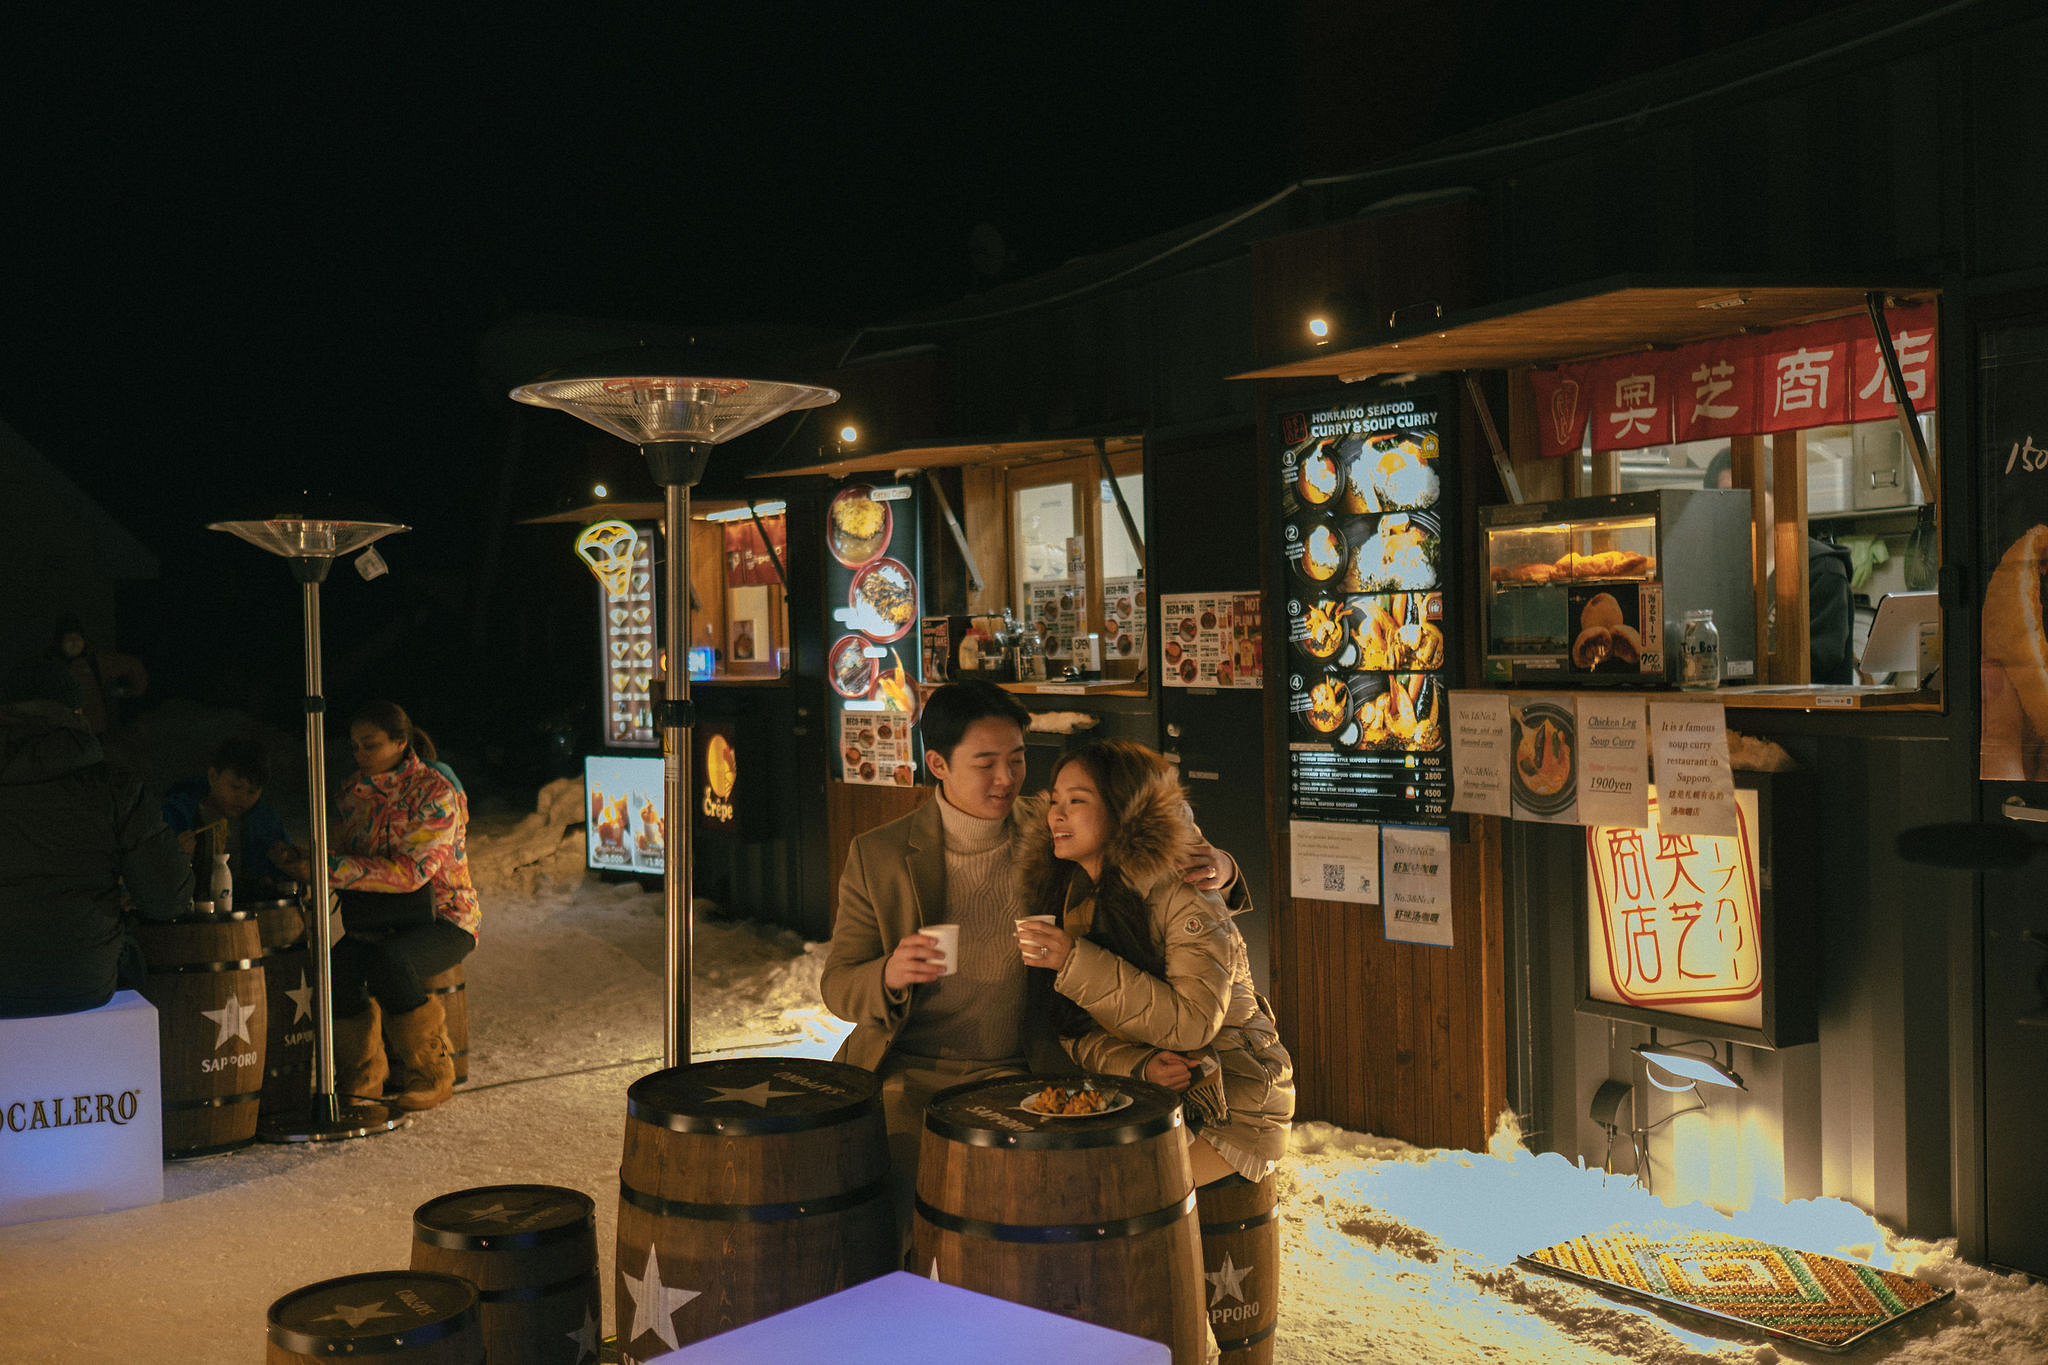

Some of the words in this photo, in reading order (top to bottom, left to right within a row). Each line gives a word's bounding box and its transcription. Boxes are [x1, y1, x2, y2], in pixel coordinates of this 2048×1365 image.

[1312, 407, 1364, 423] HOKKAIDO
[1367, 401, 1415, 417] SEAFOOD
[1311, 422, 1351, 438] CURRY
[1363, 416, 1395, 432] SOUP
[1396, 412, 1438, 428] CURRY
[1074, 639, 1090, 650] OPEN
[1681, 642, 1695, 656] Tip
[1699, 641, 1717, 653] Box
[1641, 653, 1659, 664] 700
[1588, 716, 1619, 727] Chicken
[1622, 717, 1637, 729] Leg
[1662, 722, 1669, 732] It
[1670, 721, 1677, 732] is
[1685, 722, 1715, 733] famous
[1591, 736, 1610, 748] Soup
[1612, 736, 1636, 749] Curry
[1669, 741, 1689, 751] soup
[1690, 741, 1712, 751] curry
[1666, 756, 1708, 766] restaurant
[1709, 756, 1718, 767] in
[1590, 776, 1633, 792] 1900yen
[703, 798, 734, 823] Crêpe
[201, 1051, 257, 1073] SAPPORO
[0, 1090, 138, 1132] CALERO
